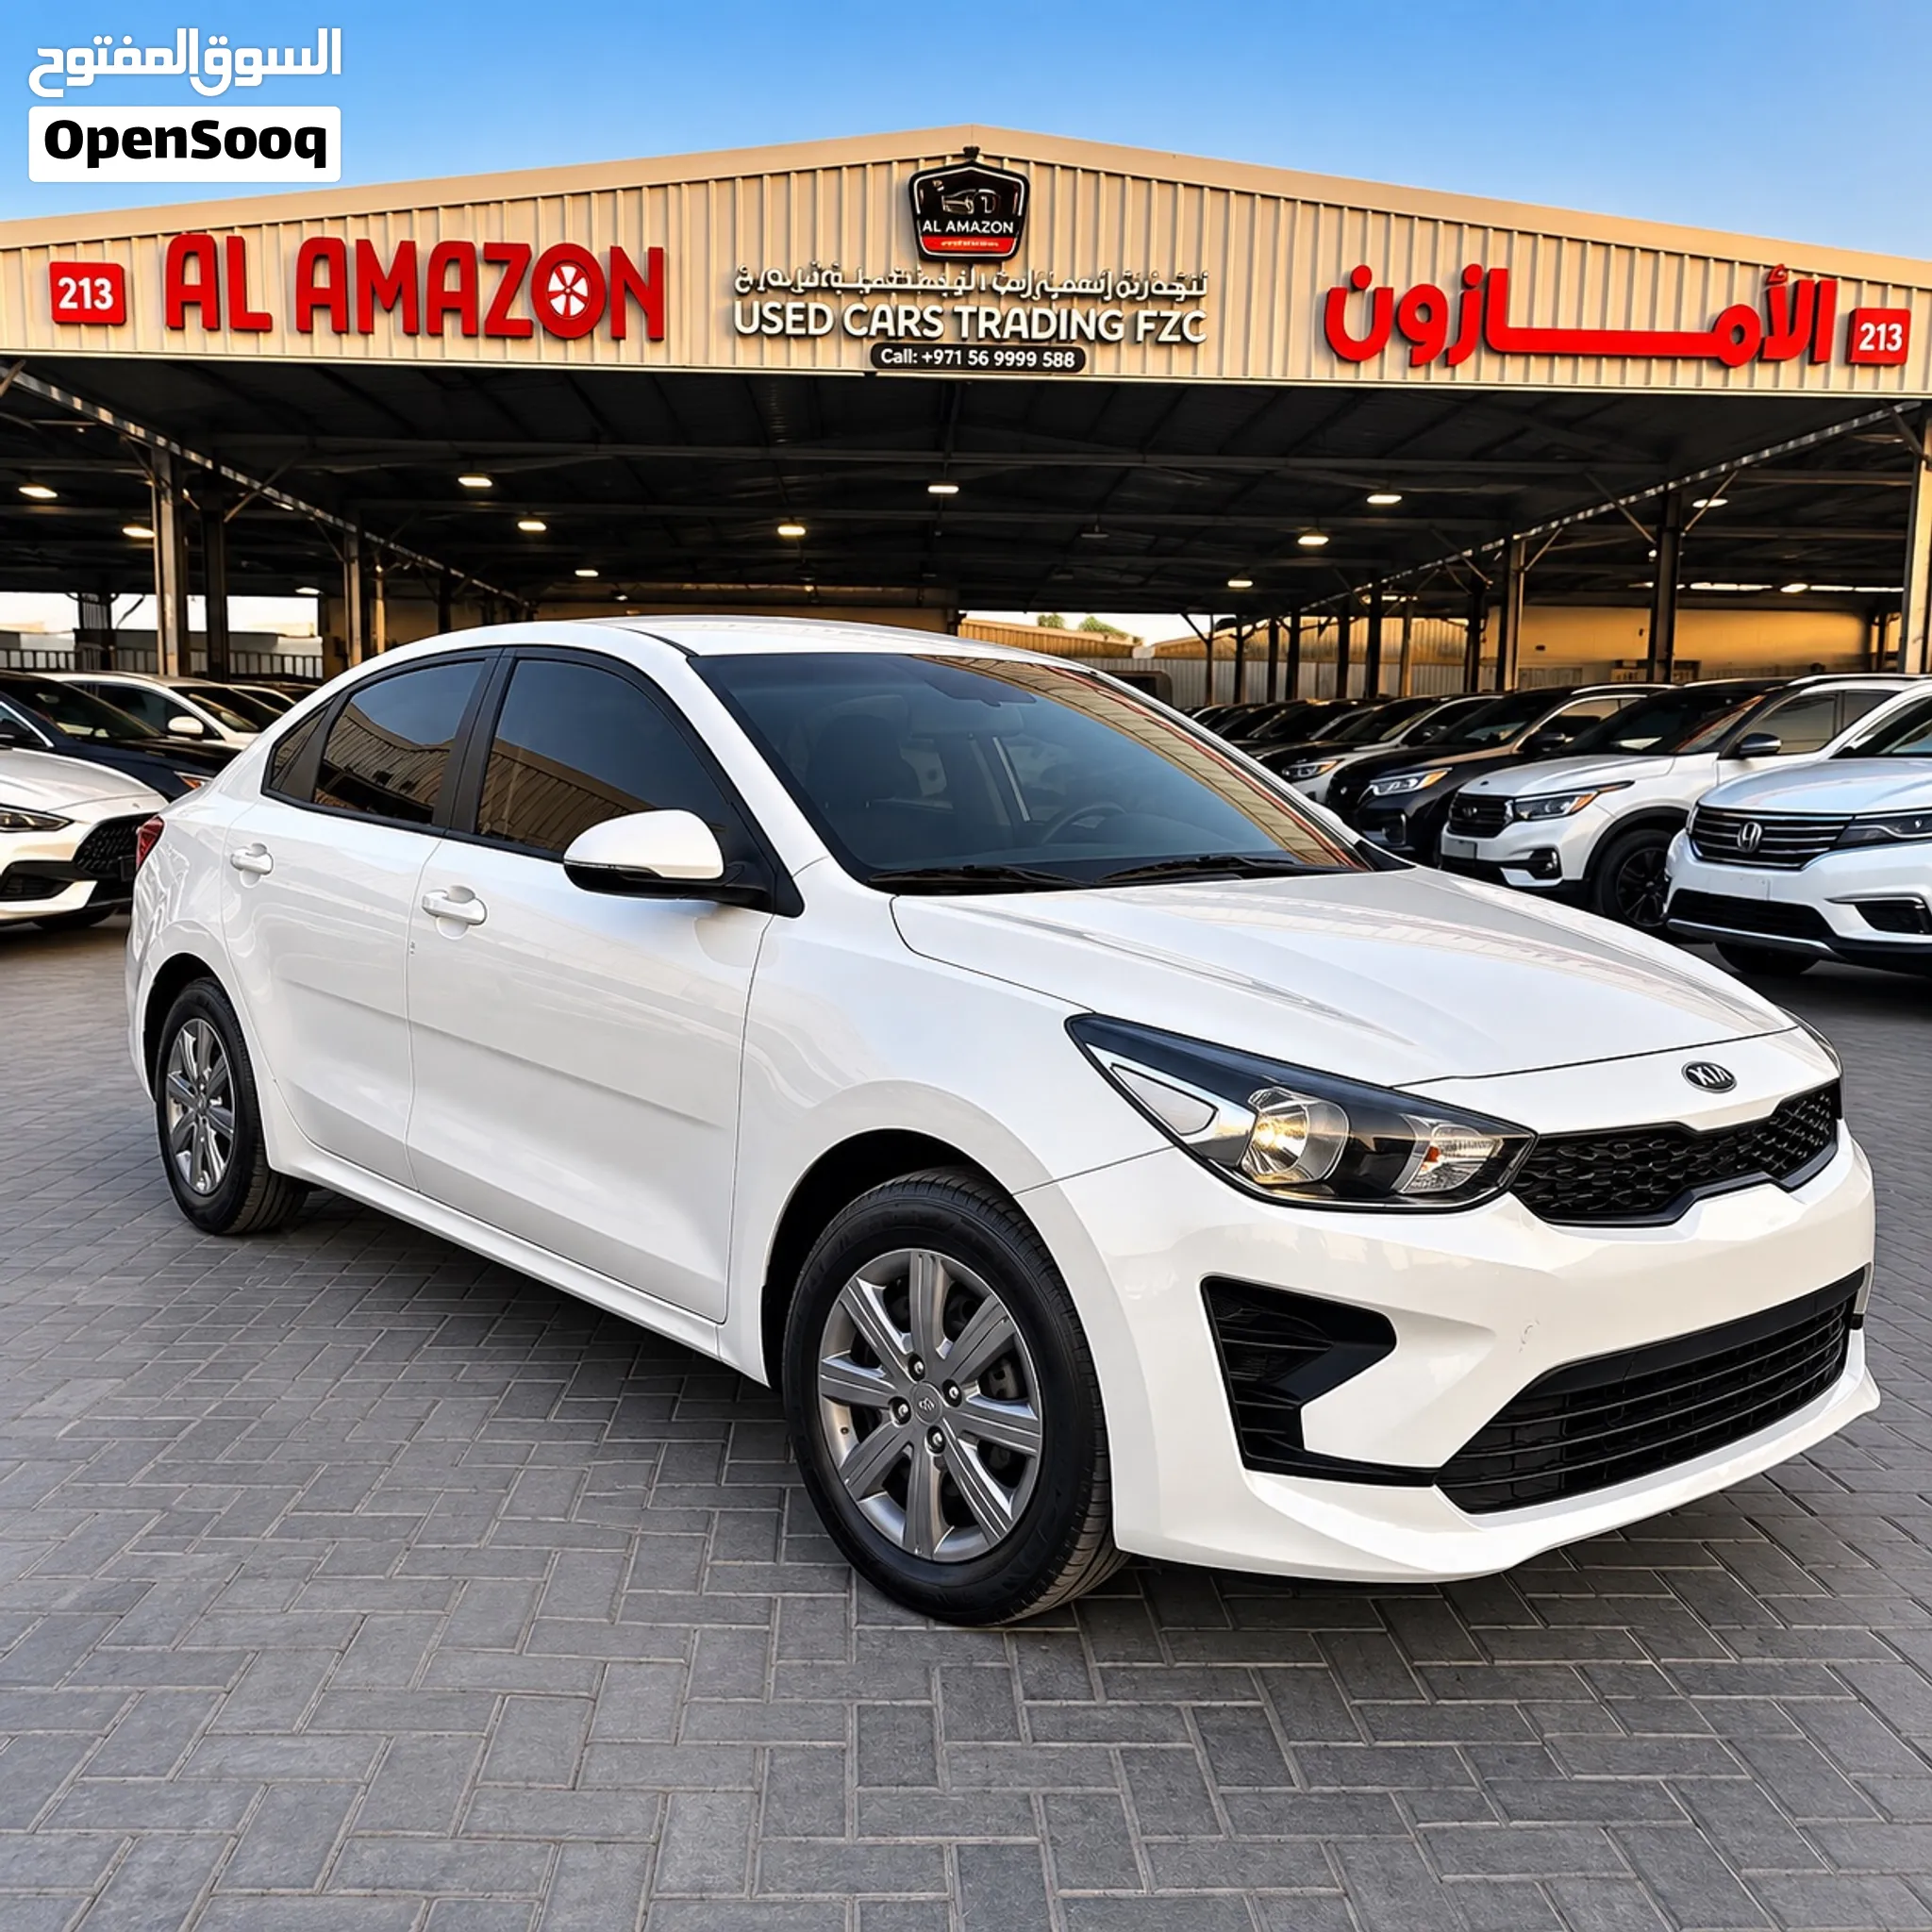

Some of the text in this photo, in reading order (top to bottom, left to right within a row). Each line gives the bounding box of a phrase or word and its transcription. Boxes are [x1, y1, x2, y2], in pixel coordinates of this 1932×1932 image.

[922, 220, 1014, 234] AL AMAZON
[58, 277, 113, 309] 213
[165, 232, 273, 331] AL
[295, 237, 664, 341] AMAZON
[734, 300, 1208, 343] USED CARS TRADING FZC
[1858, 322, 1903, 352] 213
[880, 348, 1075, 368] Call: +971 56 9999 588
